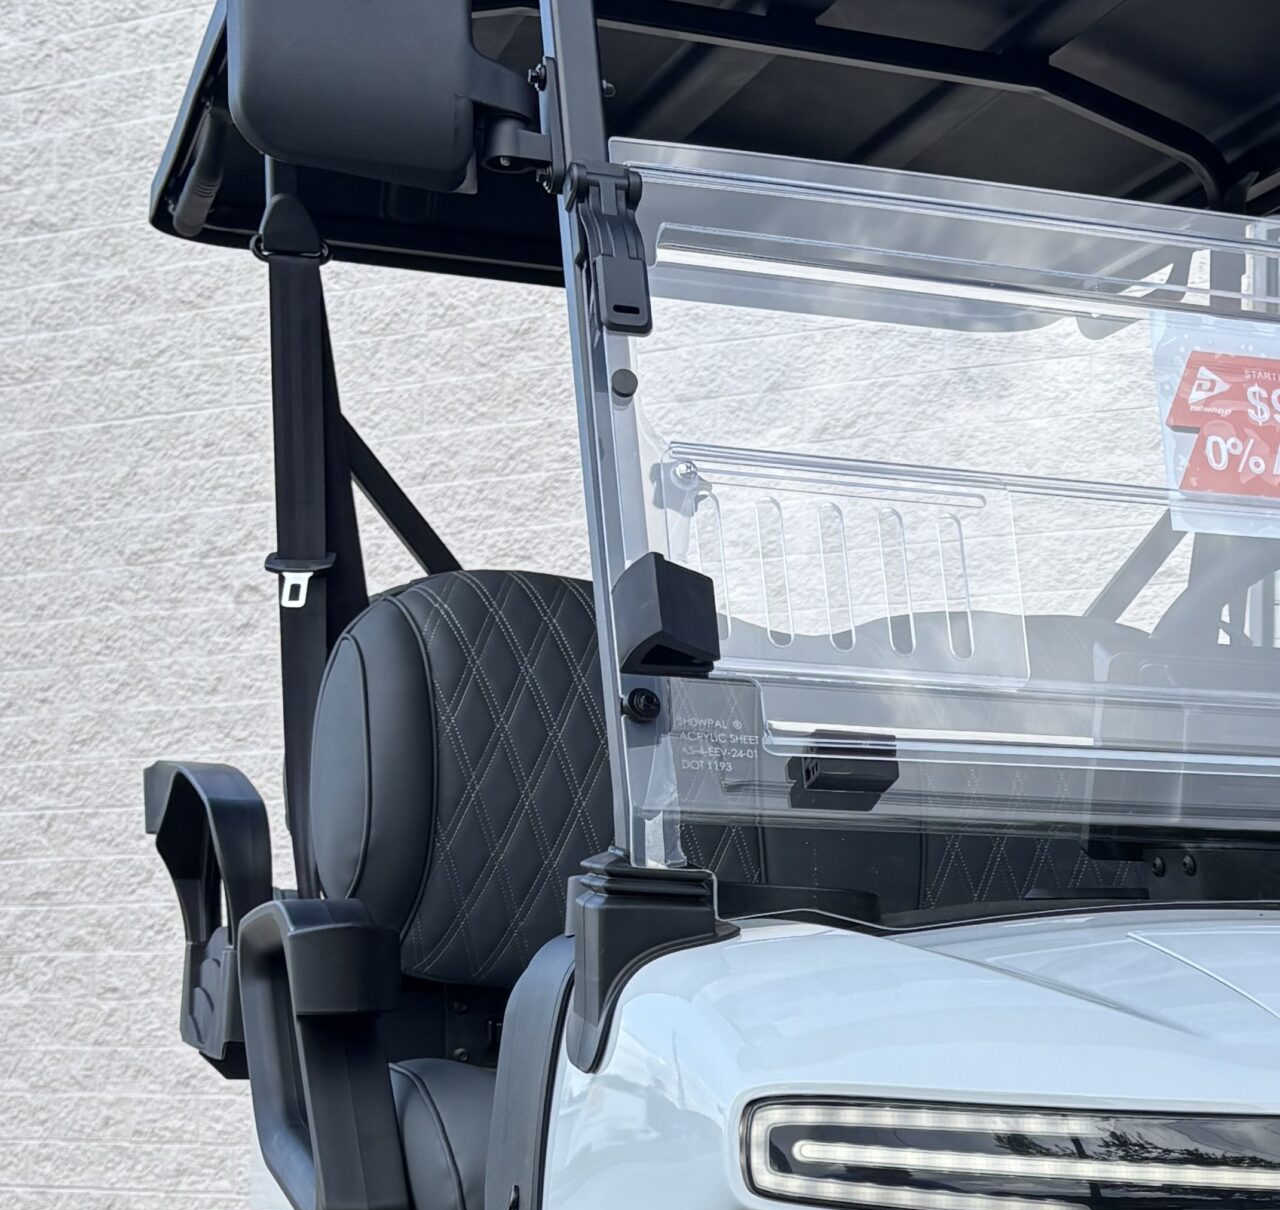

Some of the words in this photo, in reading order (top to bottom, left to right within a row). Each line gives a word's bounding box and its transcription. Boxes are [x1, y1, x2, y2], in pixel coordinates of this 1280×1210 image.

[1205, 435, 1266, 474] 0%
[680, 731, 727, 743] ACRYLIC
[729, 734, 759, 745] SHEET
[682, 759, 704, 770] DOT
[708, 760, 733, 772] 1193
